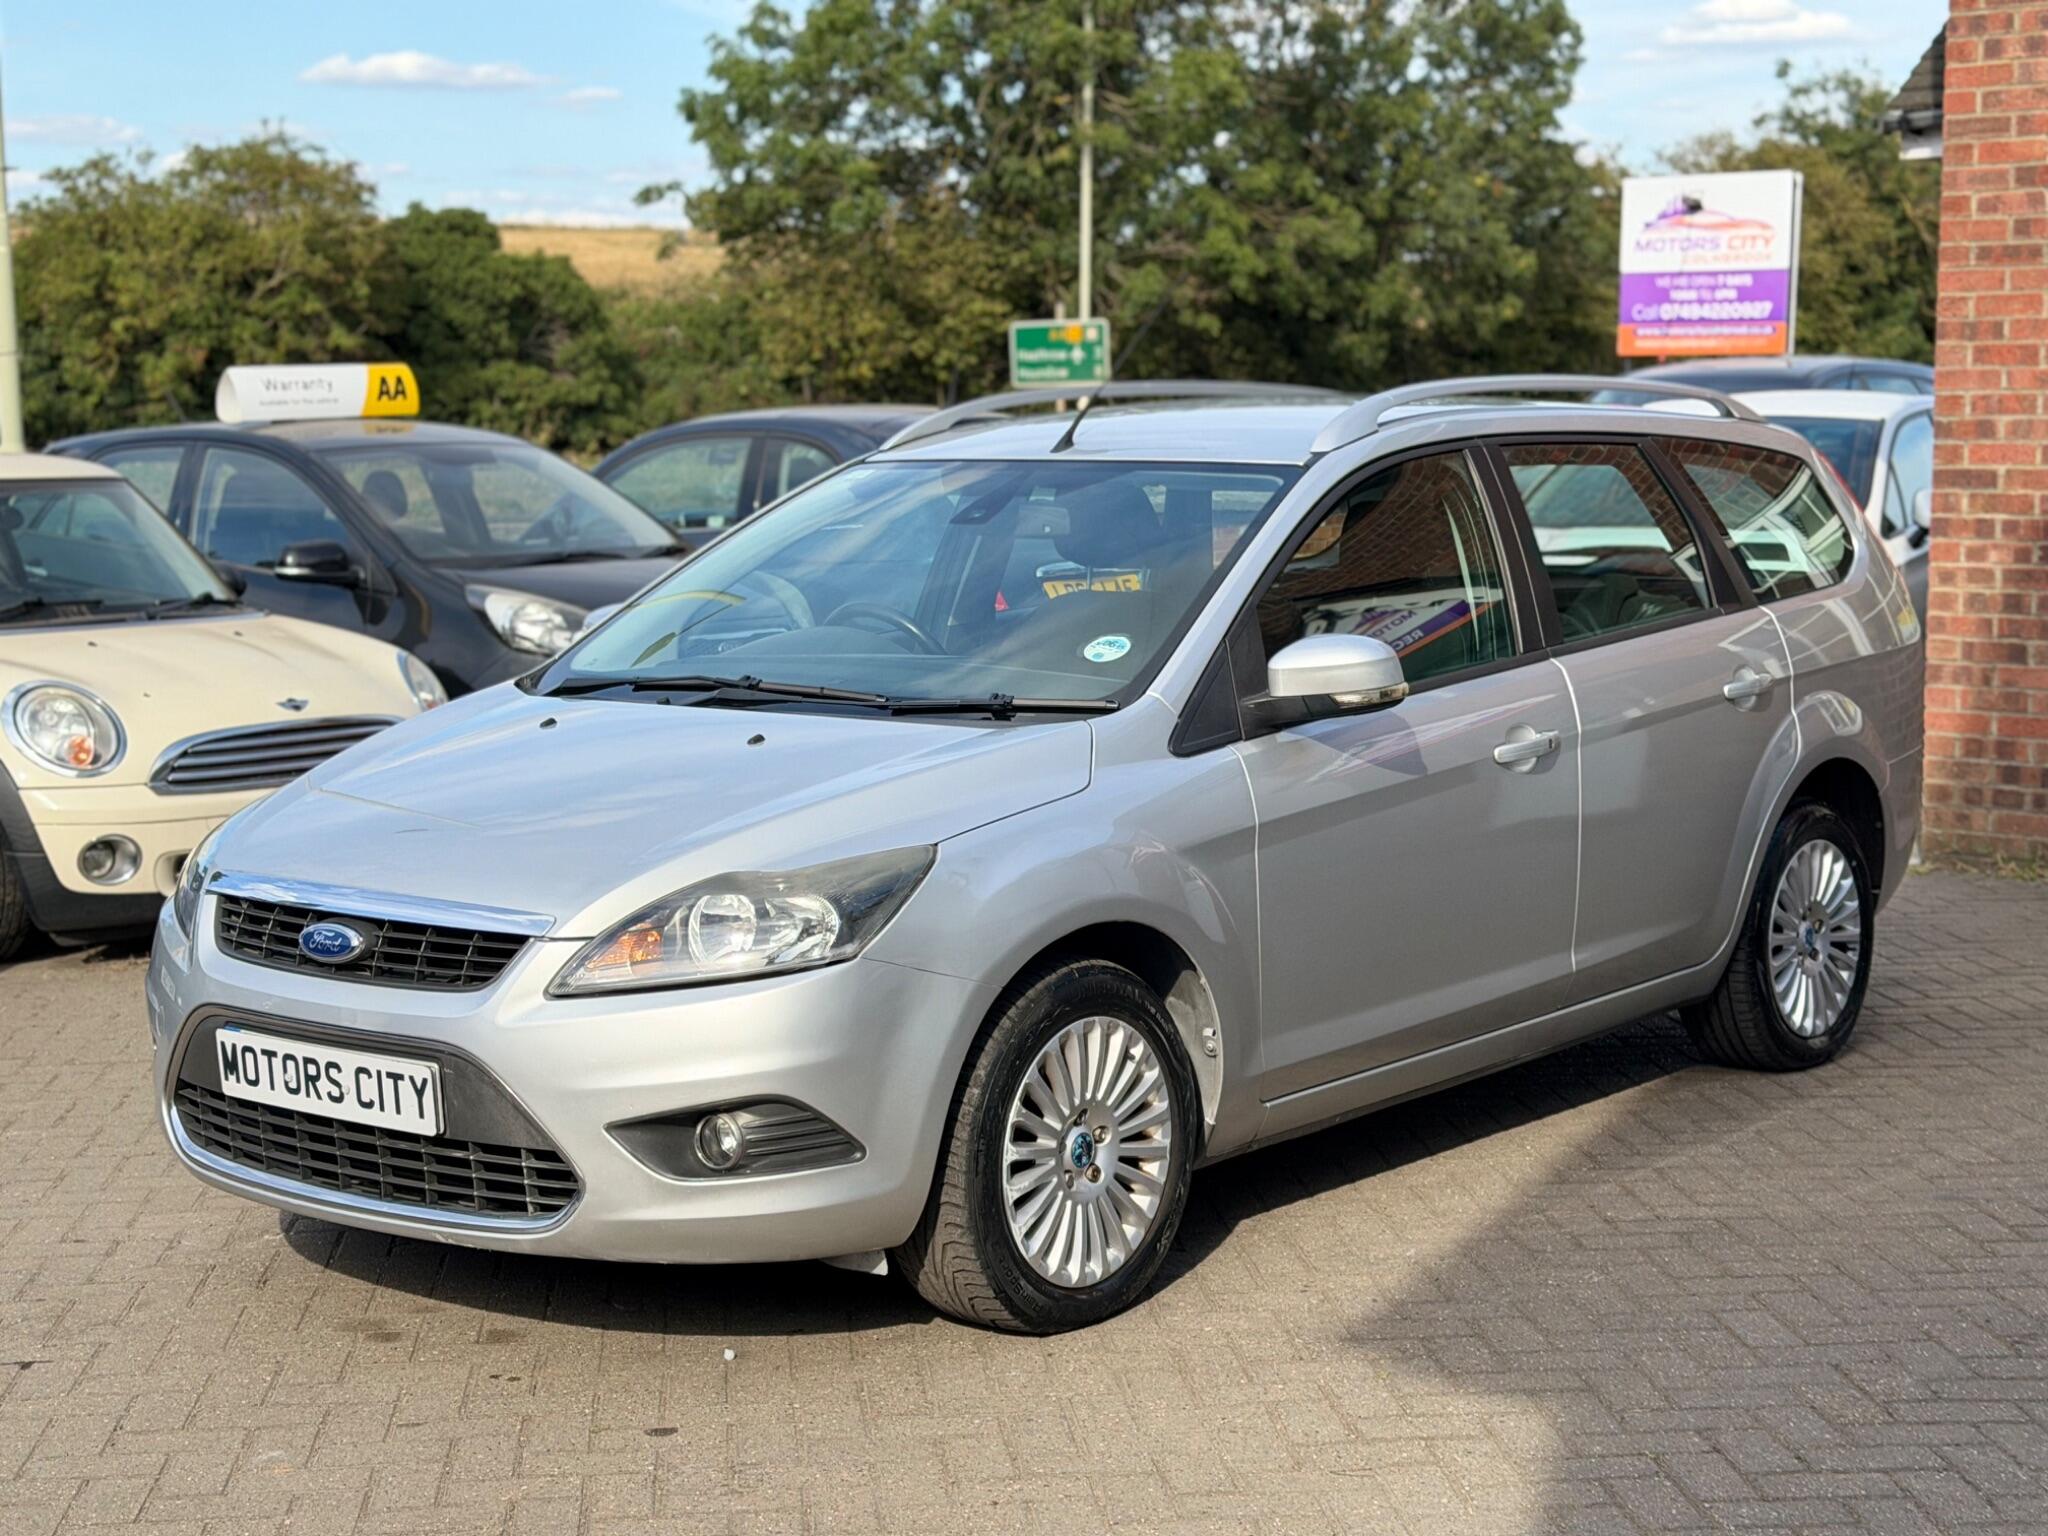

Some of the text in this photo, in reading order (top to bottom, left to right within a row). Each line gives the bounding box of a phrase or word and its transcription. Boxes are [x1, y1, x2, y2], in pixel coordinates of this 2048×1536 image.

[1634, 234, 1775, 252] MOTORS CITY
[262, 375, 408, 401] Warranty AA
[308, 929, 343, 953] Ford
[219, 1040, 428, 1120] MOTORS CITY
